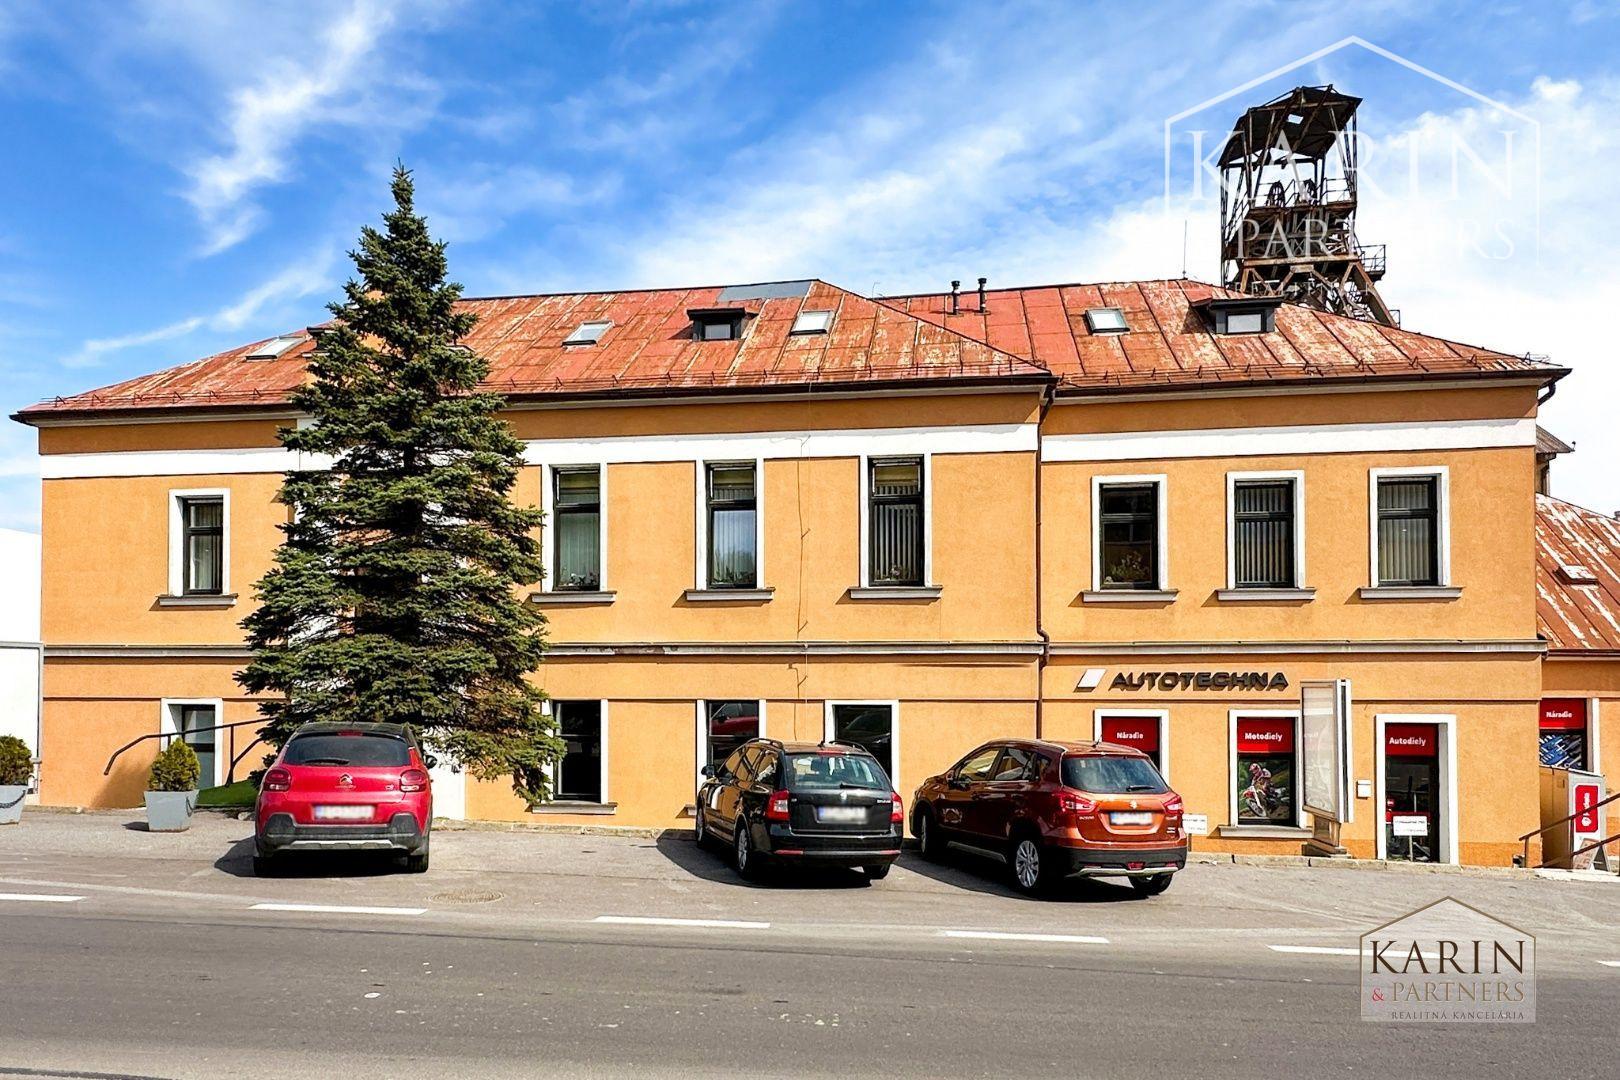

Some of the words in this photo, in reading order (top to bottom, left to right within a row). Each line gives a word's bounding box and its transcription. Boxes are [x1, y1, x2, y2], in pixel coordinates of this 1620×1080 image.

[1109, 671, 1289, 690] AUTOTECHNA
[1244, 731, 1283, 742] Motodiely
[1388, 736, 1427, 747] Autodiely
